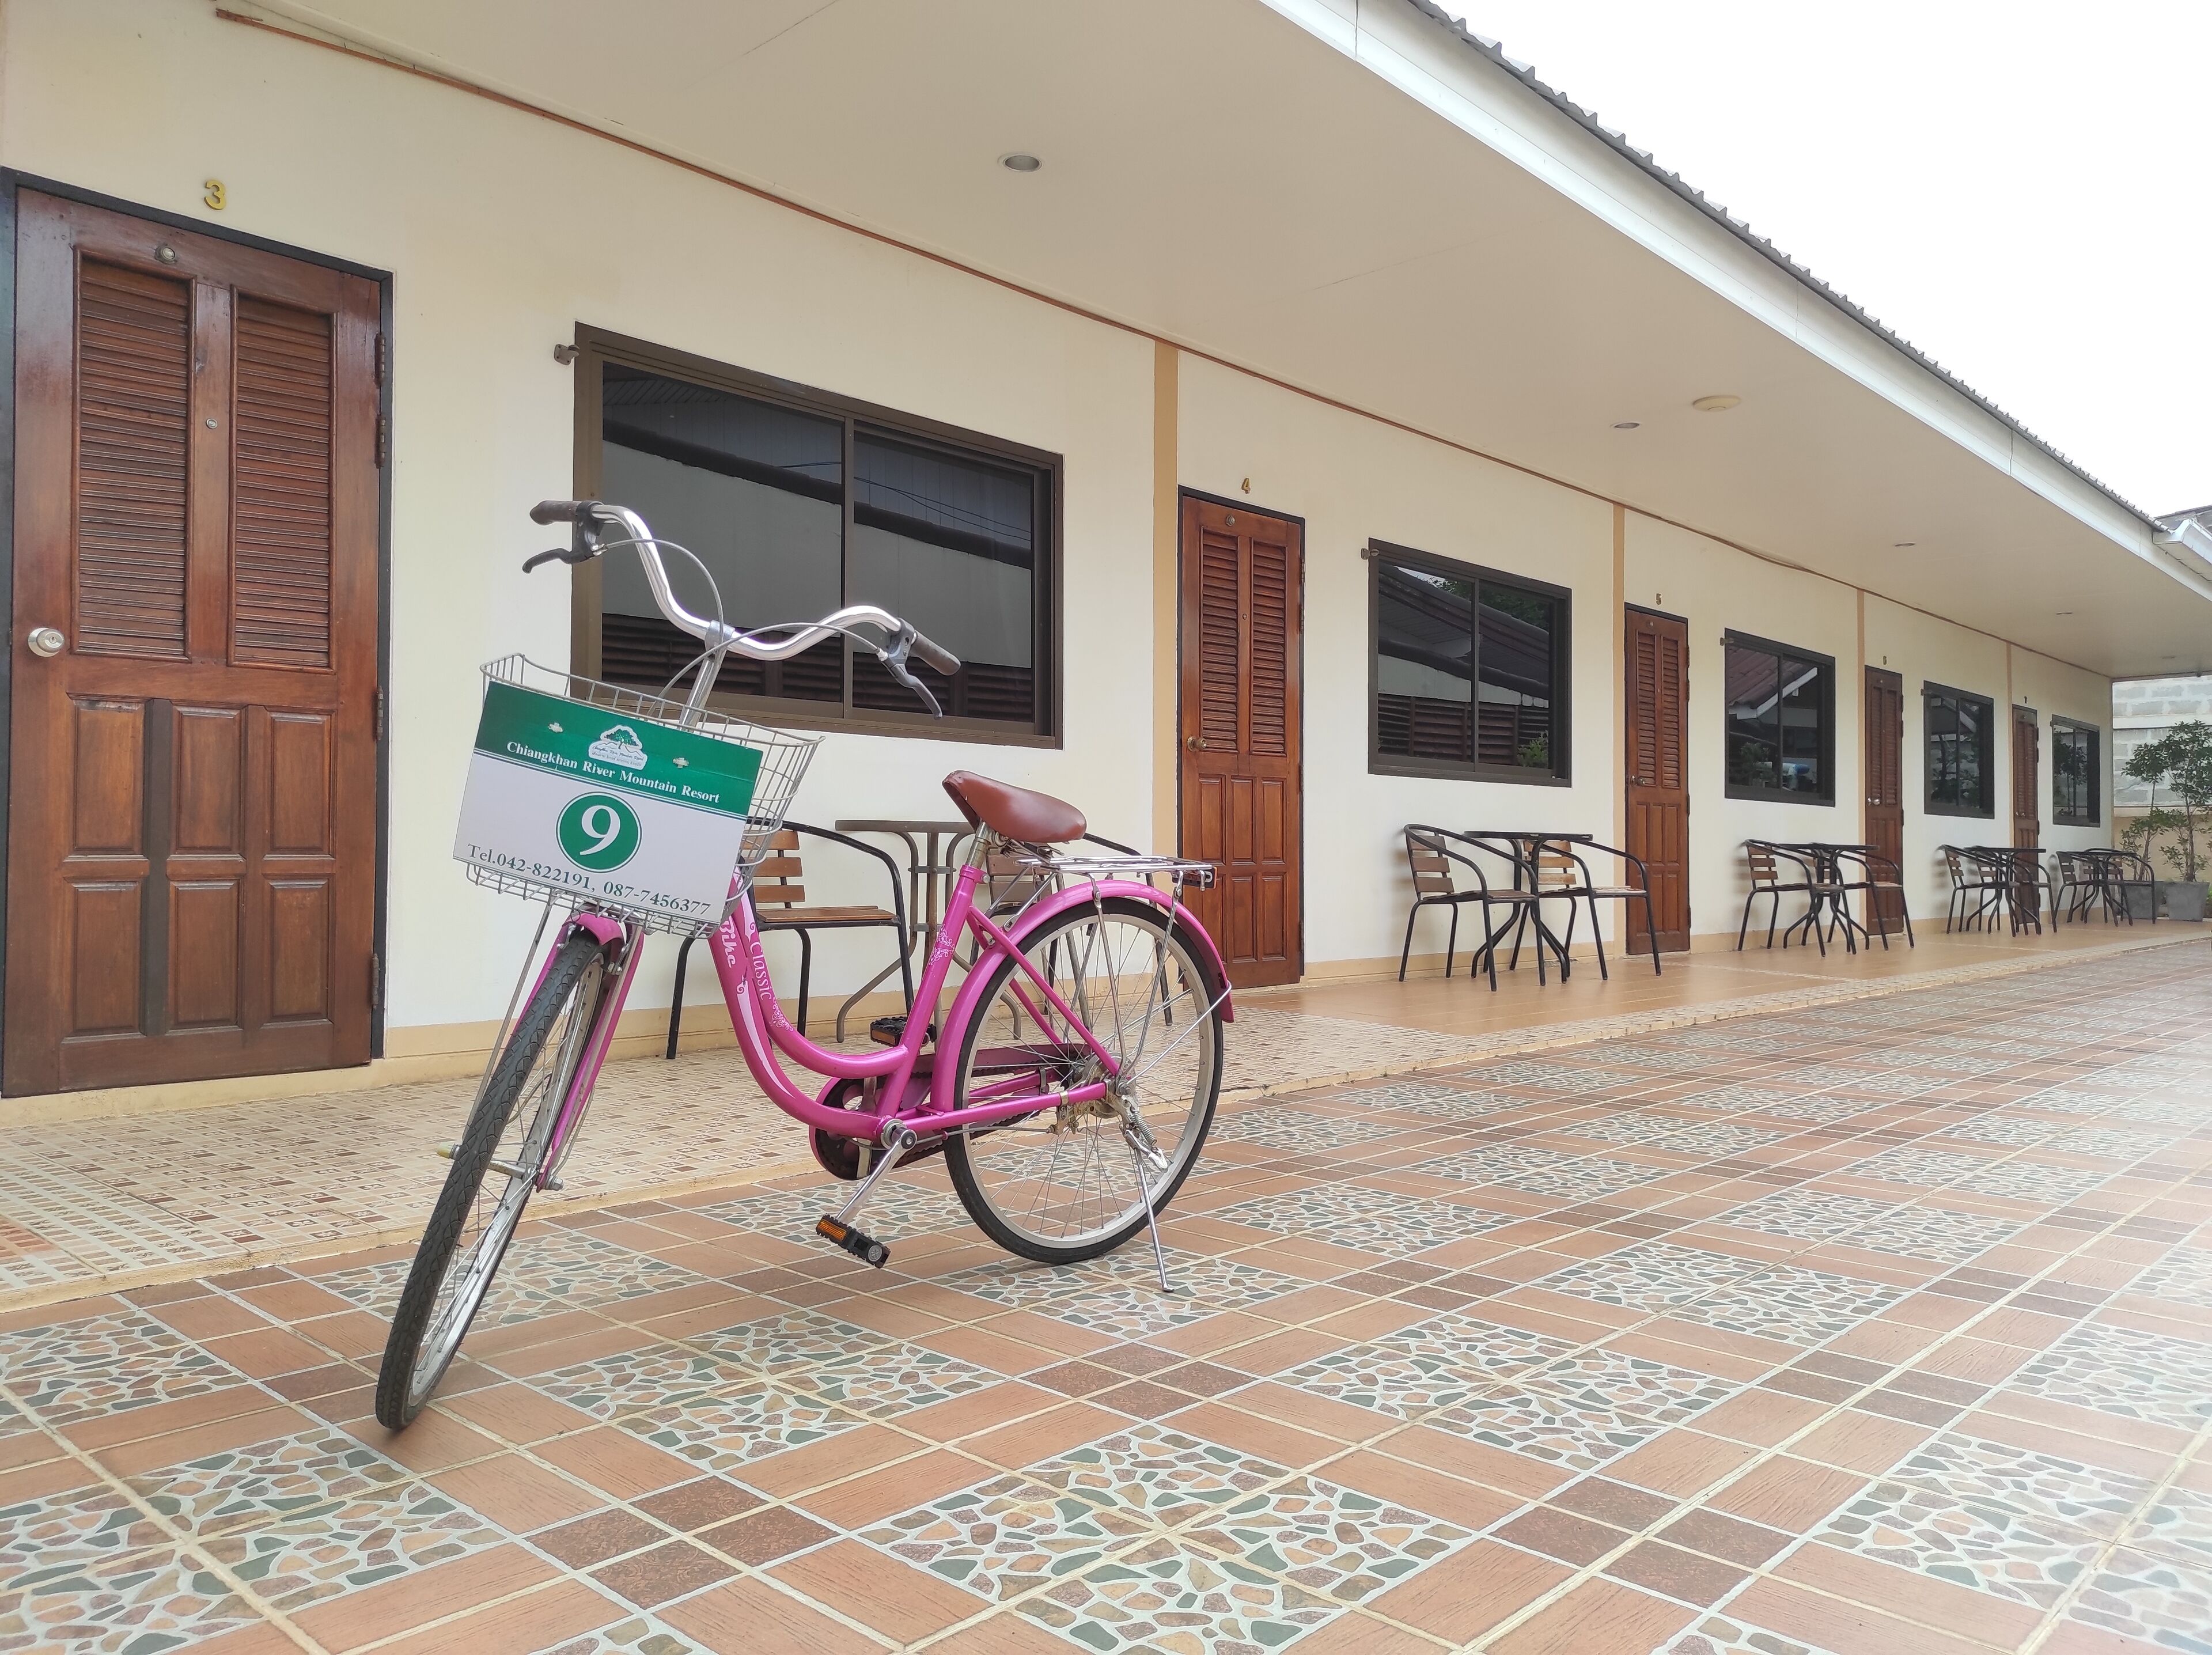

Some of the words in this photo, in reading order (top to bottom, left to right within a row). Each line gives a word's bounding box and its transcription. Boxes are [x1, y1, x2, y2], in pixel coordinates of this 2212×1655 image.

[204, 179, 226, 210] 3
[1241, 478, 1251, 494] 4
[1656, 593, 1661, 605] 5
[506, 741, 578, 769] Chiangkhan
[583, 760, 616, 778] River
[619, 770, 677, 793] Mountain
[681, 785, 720, 803] Resort
[579, 805, 621, 855] 9
[468, 843, 596, 893] Tel.042-822191,
[604, 881, 711, 915] 087-7456377
[719, 915, 737, 968] Bike
[750, 941, 772, 1001] Classic
